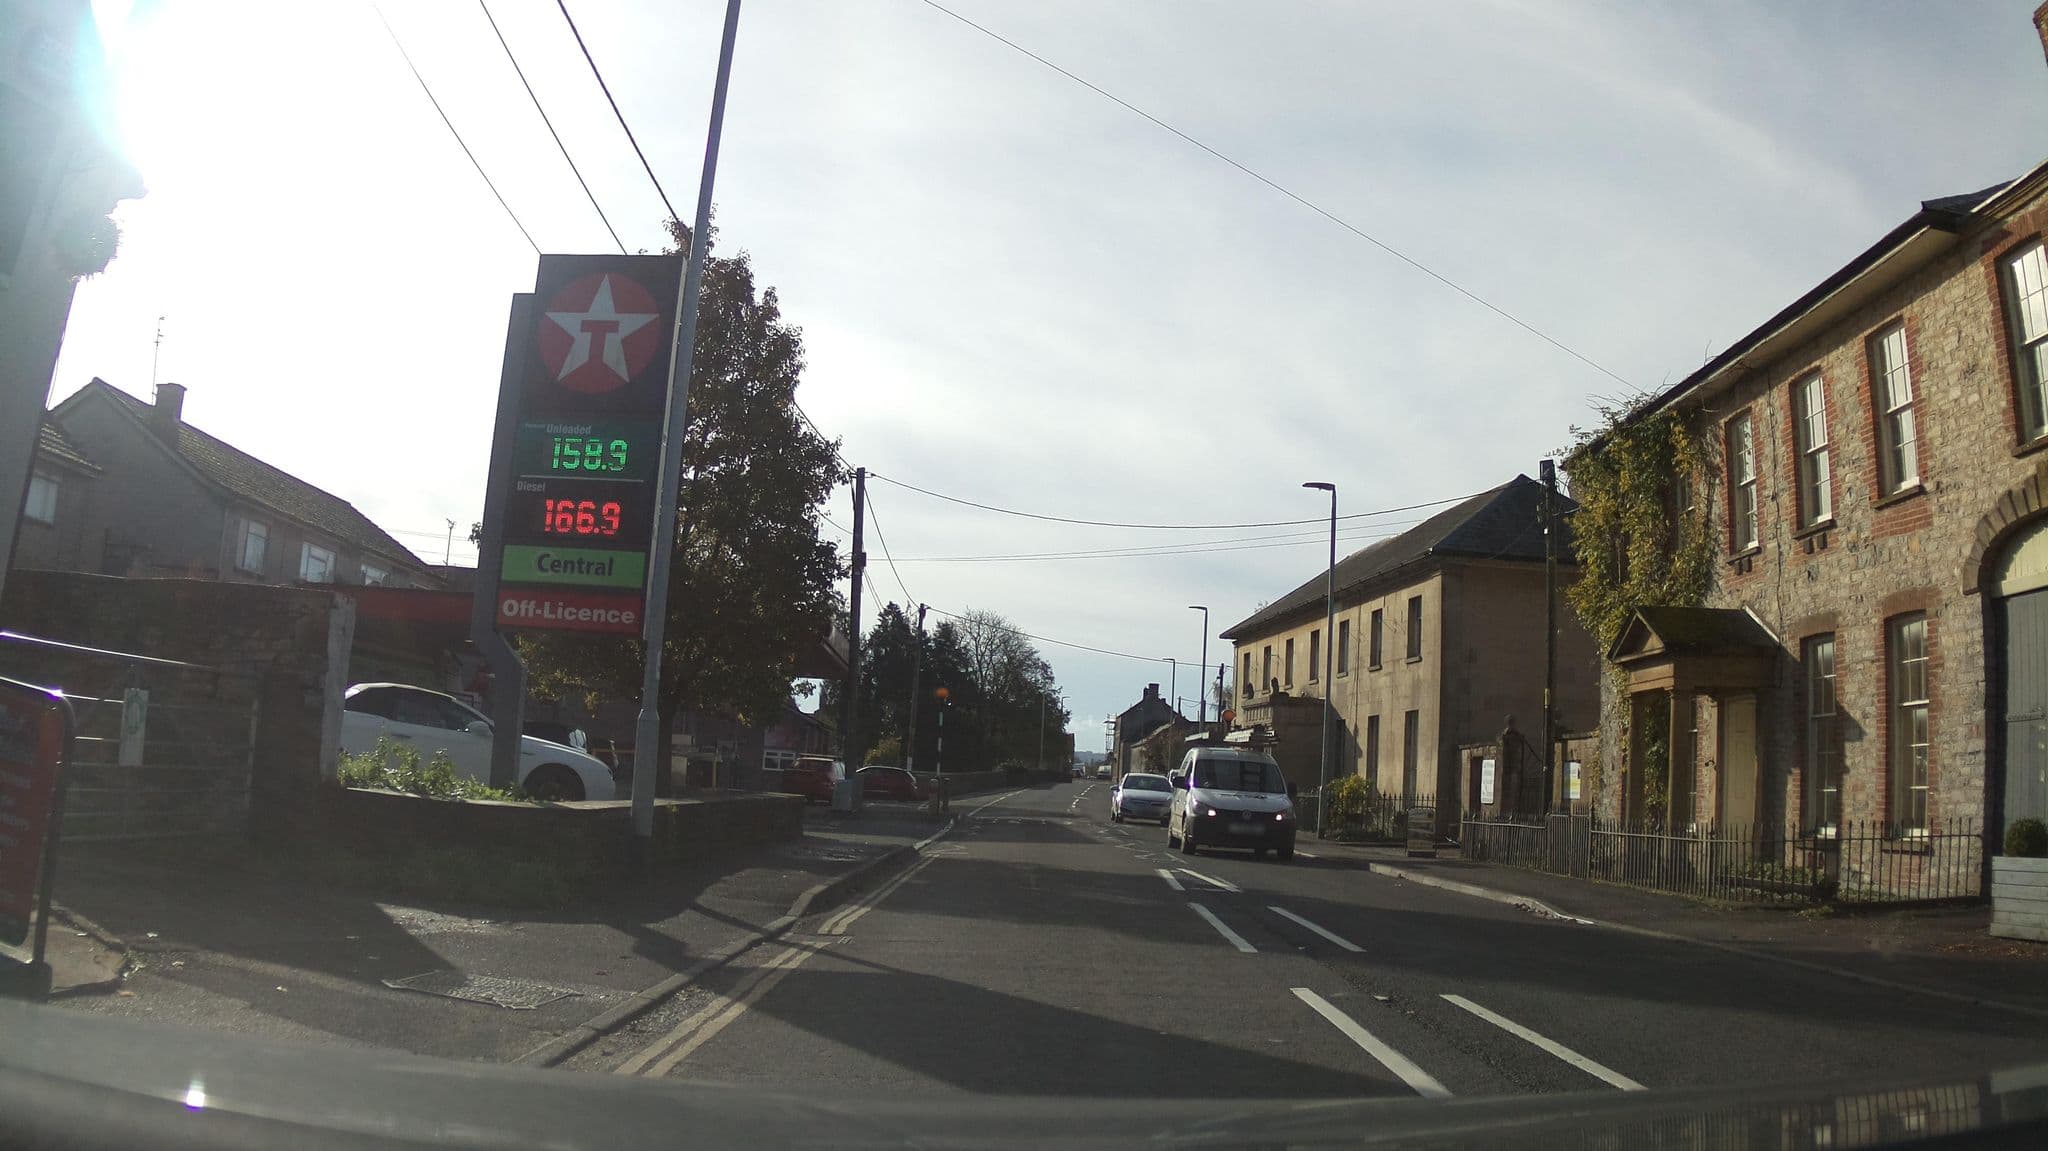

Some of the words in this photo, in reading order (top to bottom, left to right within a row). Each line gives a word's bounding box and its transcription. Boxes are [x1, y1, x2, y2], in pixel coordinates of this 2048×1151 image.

[552, 437, 629, 472] 158.9
[517, 480, 546, 492] Diesel
[544, 499, 621, 535] 166.9
[537, 553, 614, 576] Central
[502, 599, 635, 624] Off-Licence
